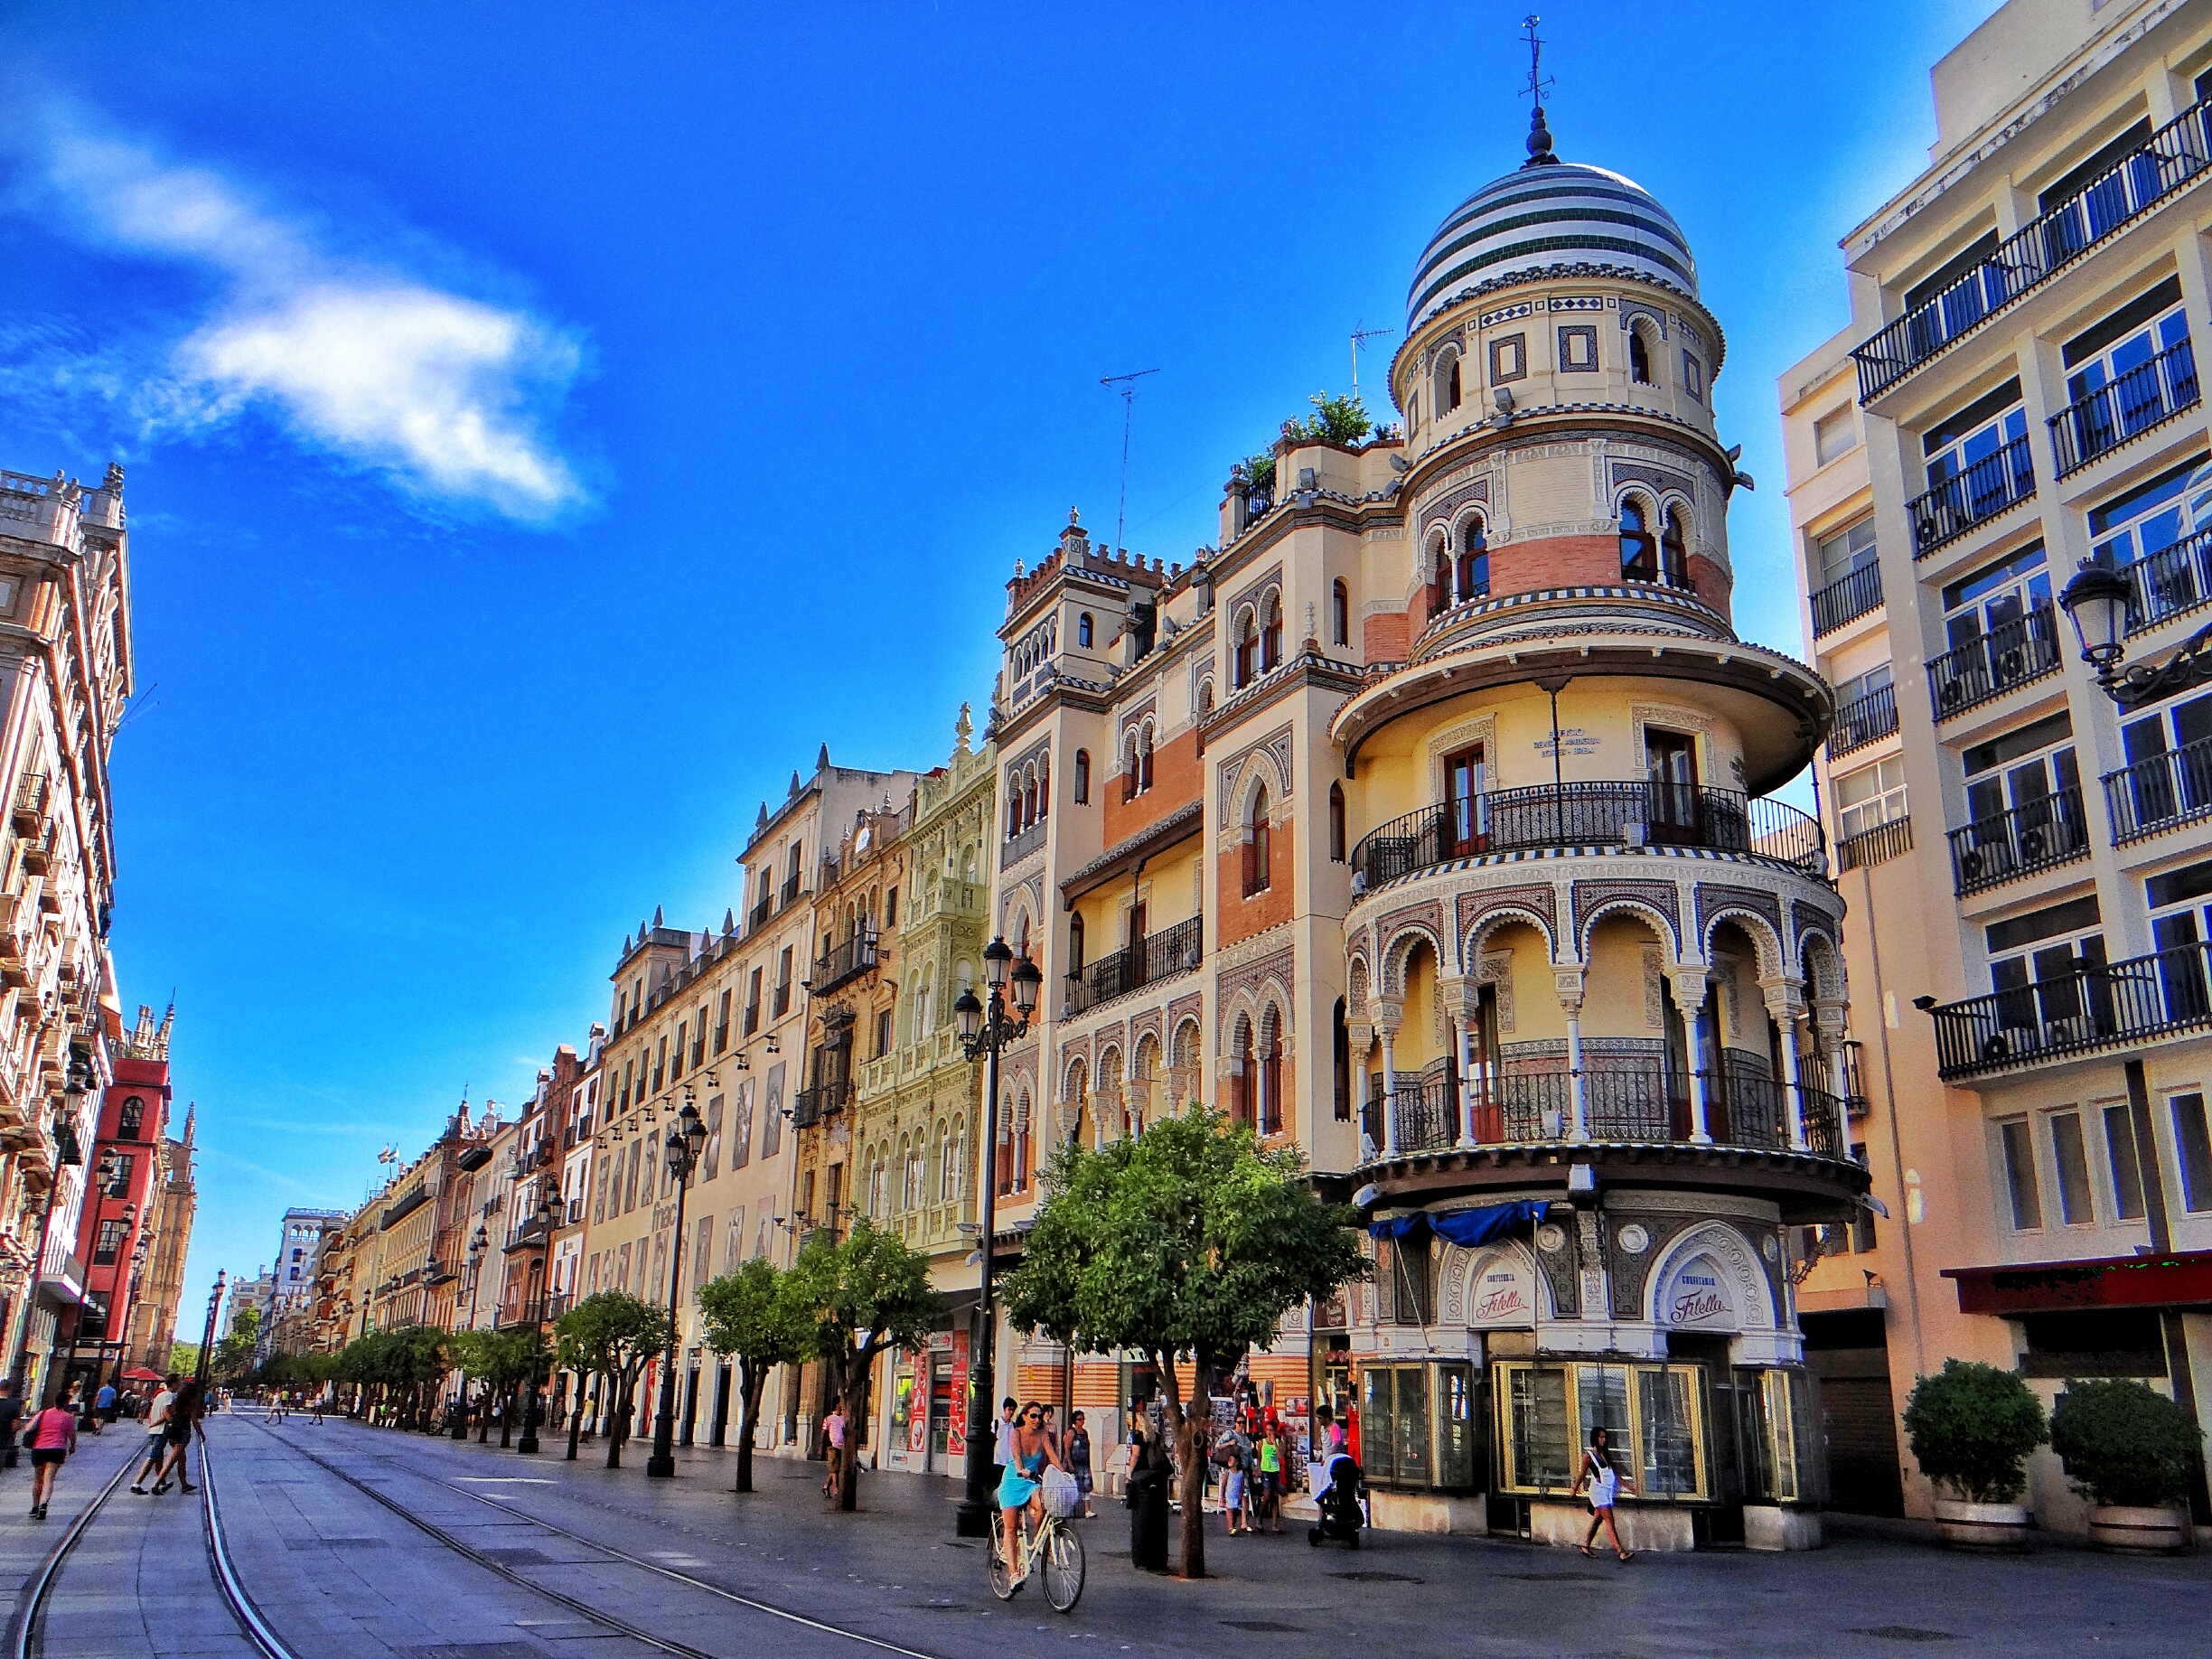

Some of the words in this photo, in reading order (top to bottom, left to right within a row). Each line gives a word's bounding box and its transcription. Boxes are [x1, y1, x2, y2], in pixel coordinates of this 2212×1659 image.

[1565, 737, 1599, 745] ANTIGUA
[651, 1201, 677, 1233] fnac
[1682, 1275, 1716, 1286] CONFITERIA
[1476, 1287, 1530, 1320] Filella
[1670, 1288, 1733, 1324] Filella
